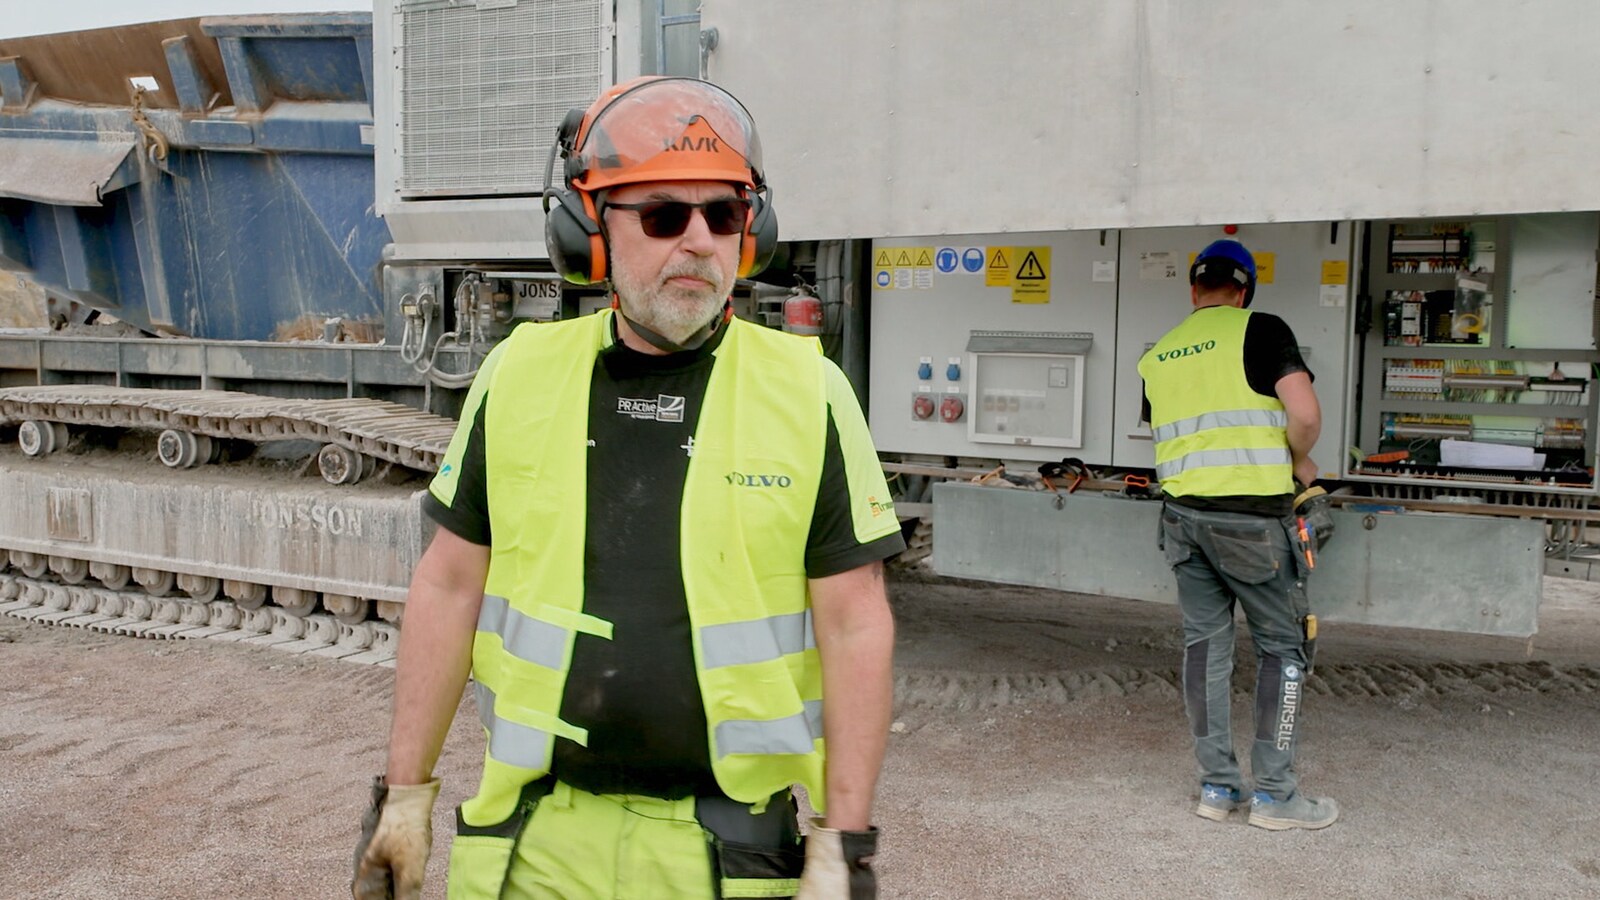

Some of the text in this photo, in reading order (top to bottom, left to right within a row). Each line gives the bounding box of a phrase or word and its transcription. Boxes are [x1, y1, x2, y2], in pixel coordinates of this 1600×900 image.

[663, 136, 719, 153] KASK
[1166, 270, 1177, 278] 24
[1157, 340, 1216, 362] VOLVO
[618, 400, 657, 413] PR Active
[724, 471, 792, 489] VOLVO
[246, 498, 362, 537] JONSSON
